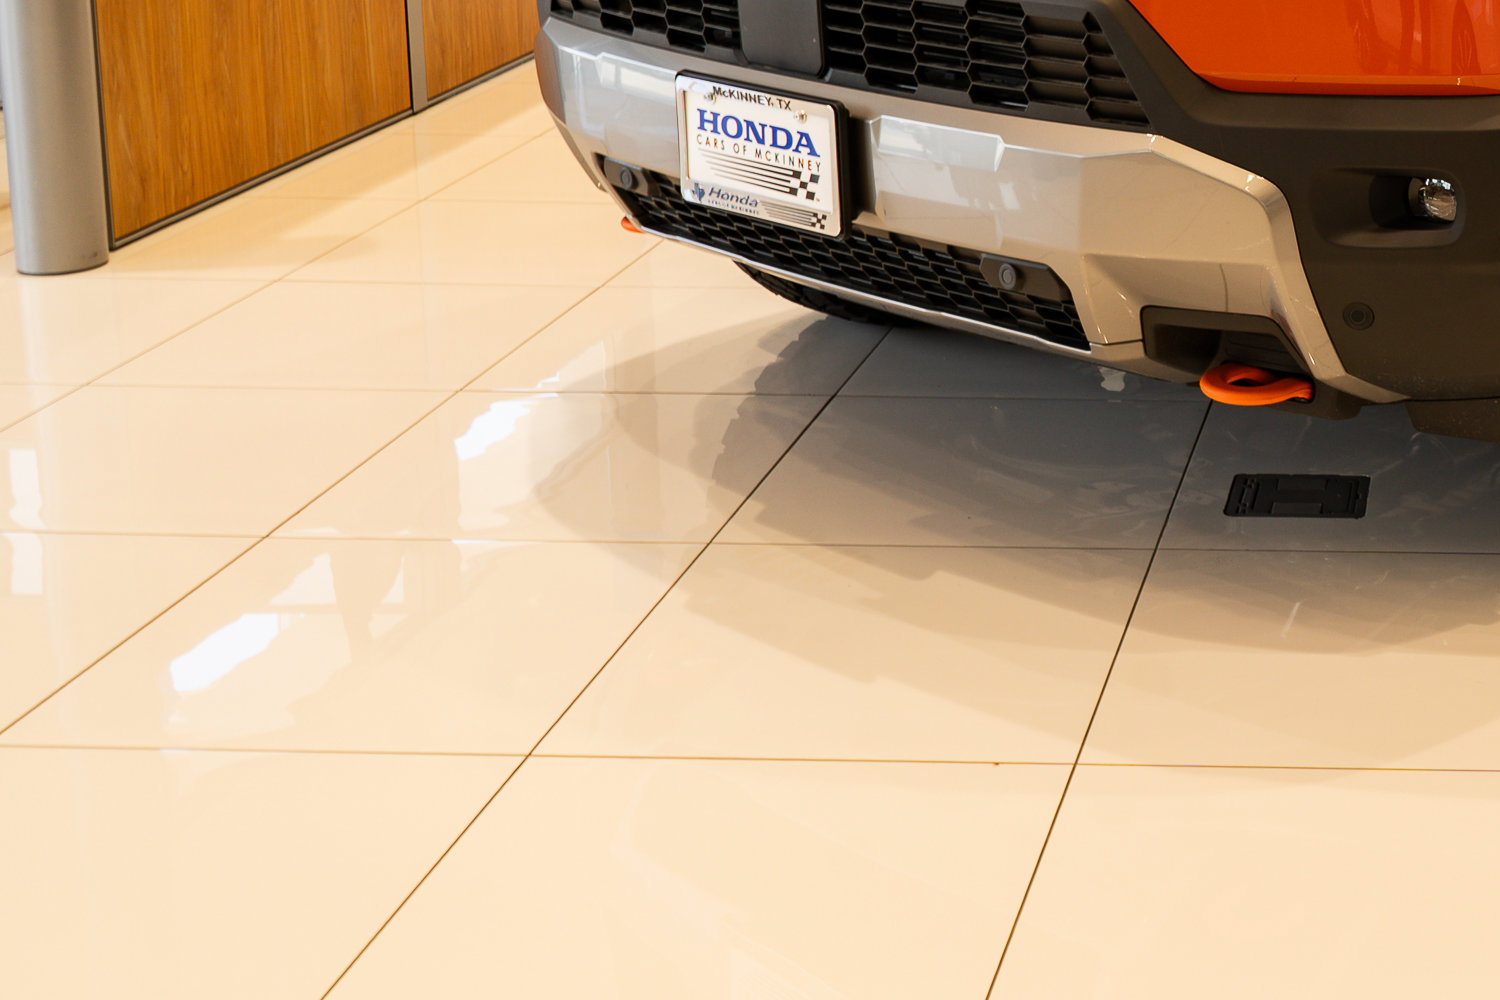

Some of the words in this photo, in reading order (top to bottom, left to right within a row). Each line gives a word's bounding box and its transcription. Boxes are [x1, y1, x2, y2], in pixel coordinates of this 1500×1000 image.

[777, 98, 792, 112] TX
[697, 108, 821, 158] HONDA
[696, 134, 725, 151] CARS
[733, 143, 748, 156] OF
[755, 149, 821, 173] MCKINNEY
[708, 186, 759, 208] Honda
